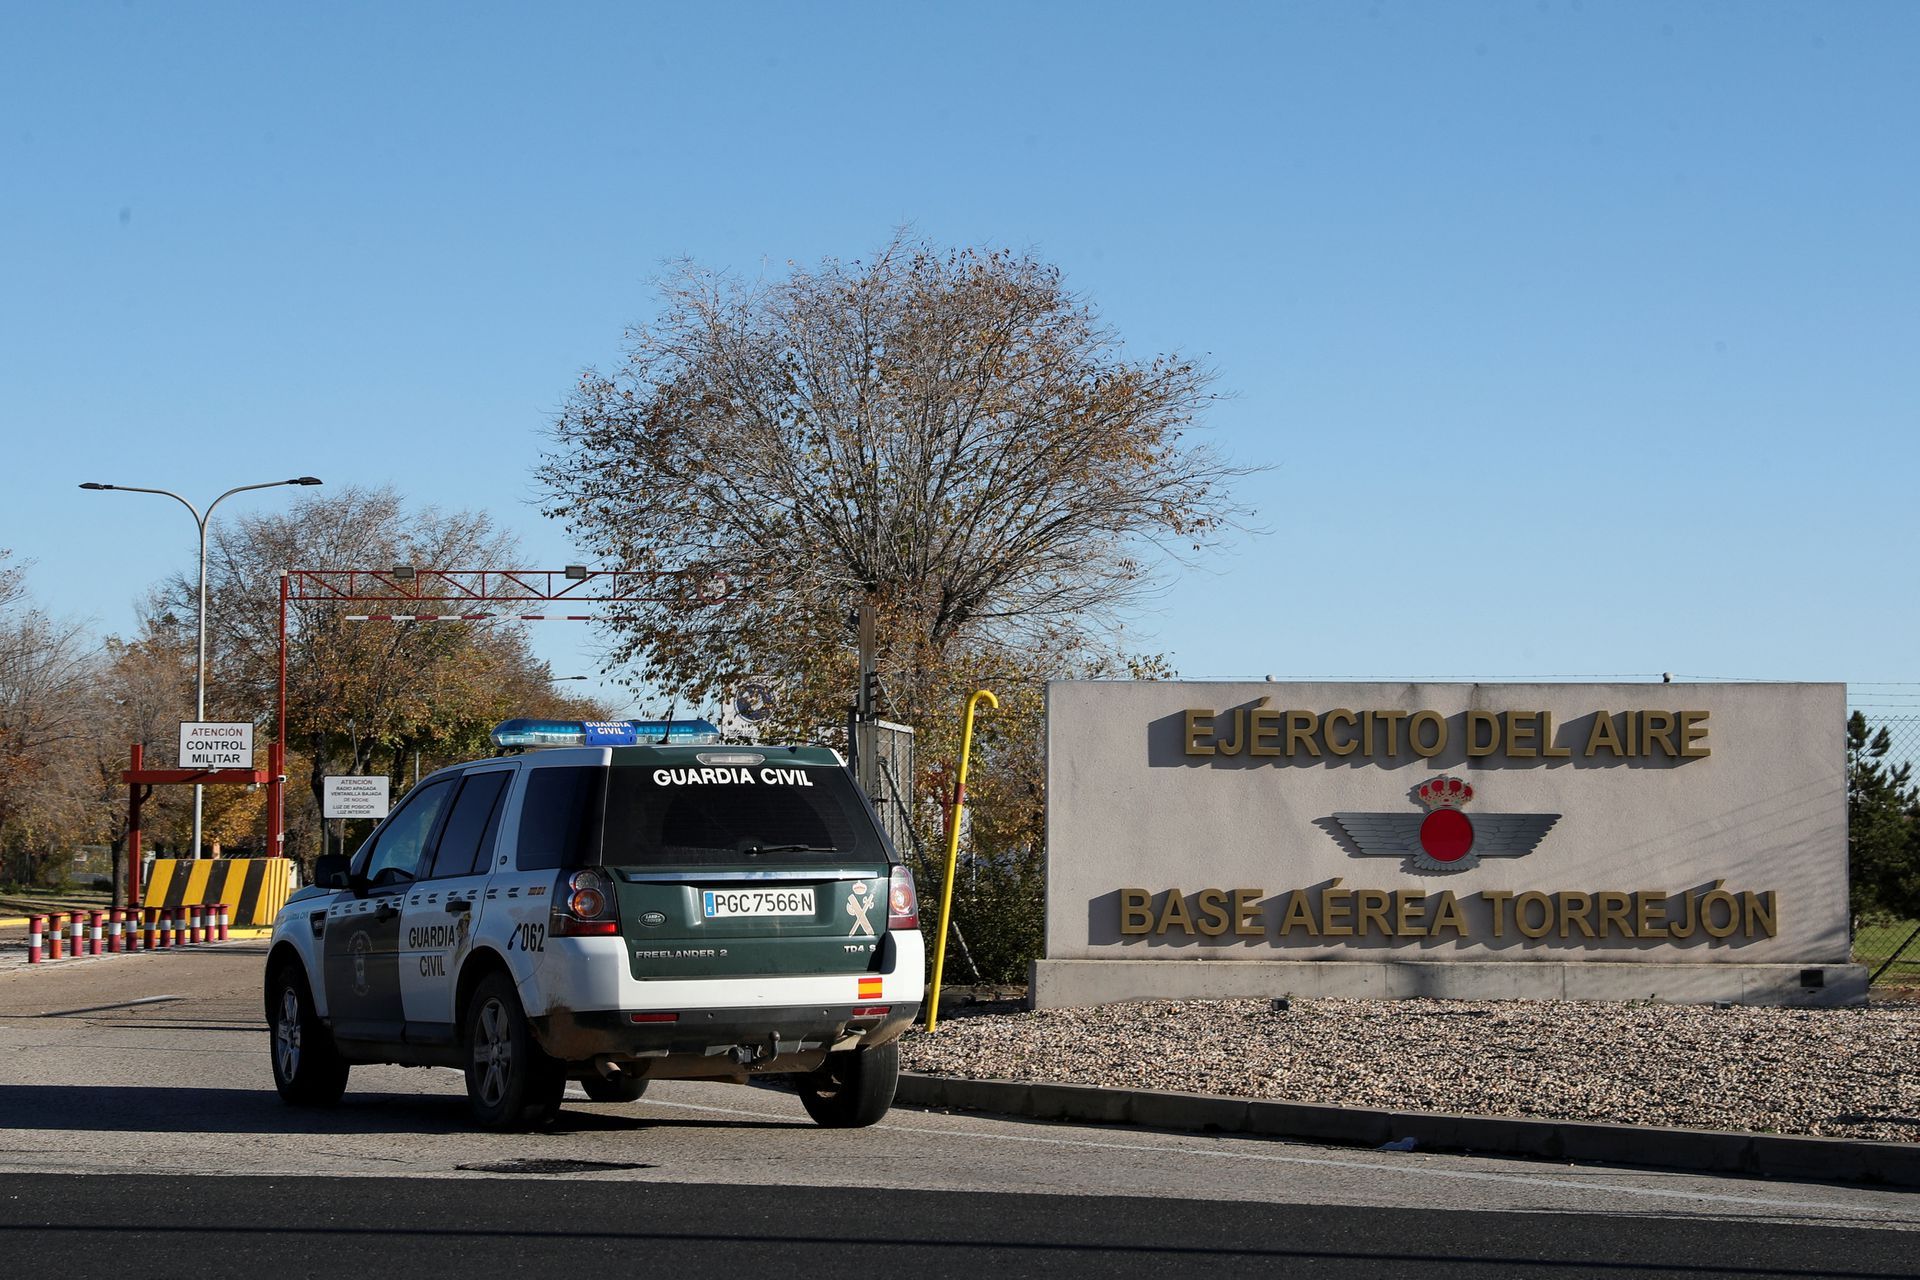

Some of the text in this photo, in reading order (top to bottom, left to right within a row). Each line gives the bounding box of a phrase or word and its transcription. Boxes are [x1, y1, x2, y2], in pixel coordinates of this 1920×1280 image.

[191, 727, 243, 737] ATENCIÓN
[597, 727, 625, 735] CIVIL
[1185, 696, 1712, 758] EJÉRCITO DEL AIRE
[186, 741, 247, 751] CONTROL
[191, 754, 241, 764] MILITAR
[653, 768, 814, 787] GUARDIA CIVIL
[1121, 877, 1778, 938] BASE AÉREA TORREJÓN
[409, 925, 456, 948] GUARDIA
[521, 923, 545, 952] 062
[635, 949, 728, 959] FREELANDER 2
[419, 955, 446, 977] CIVIL
